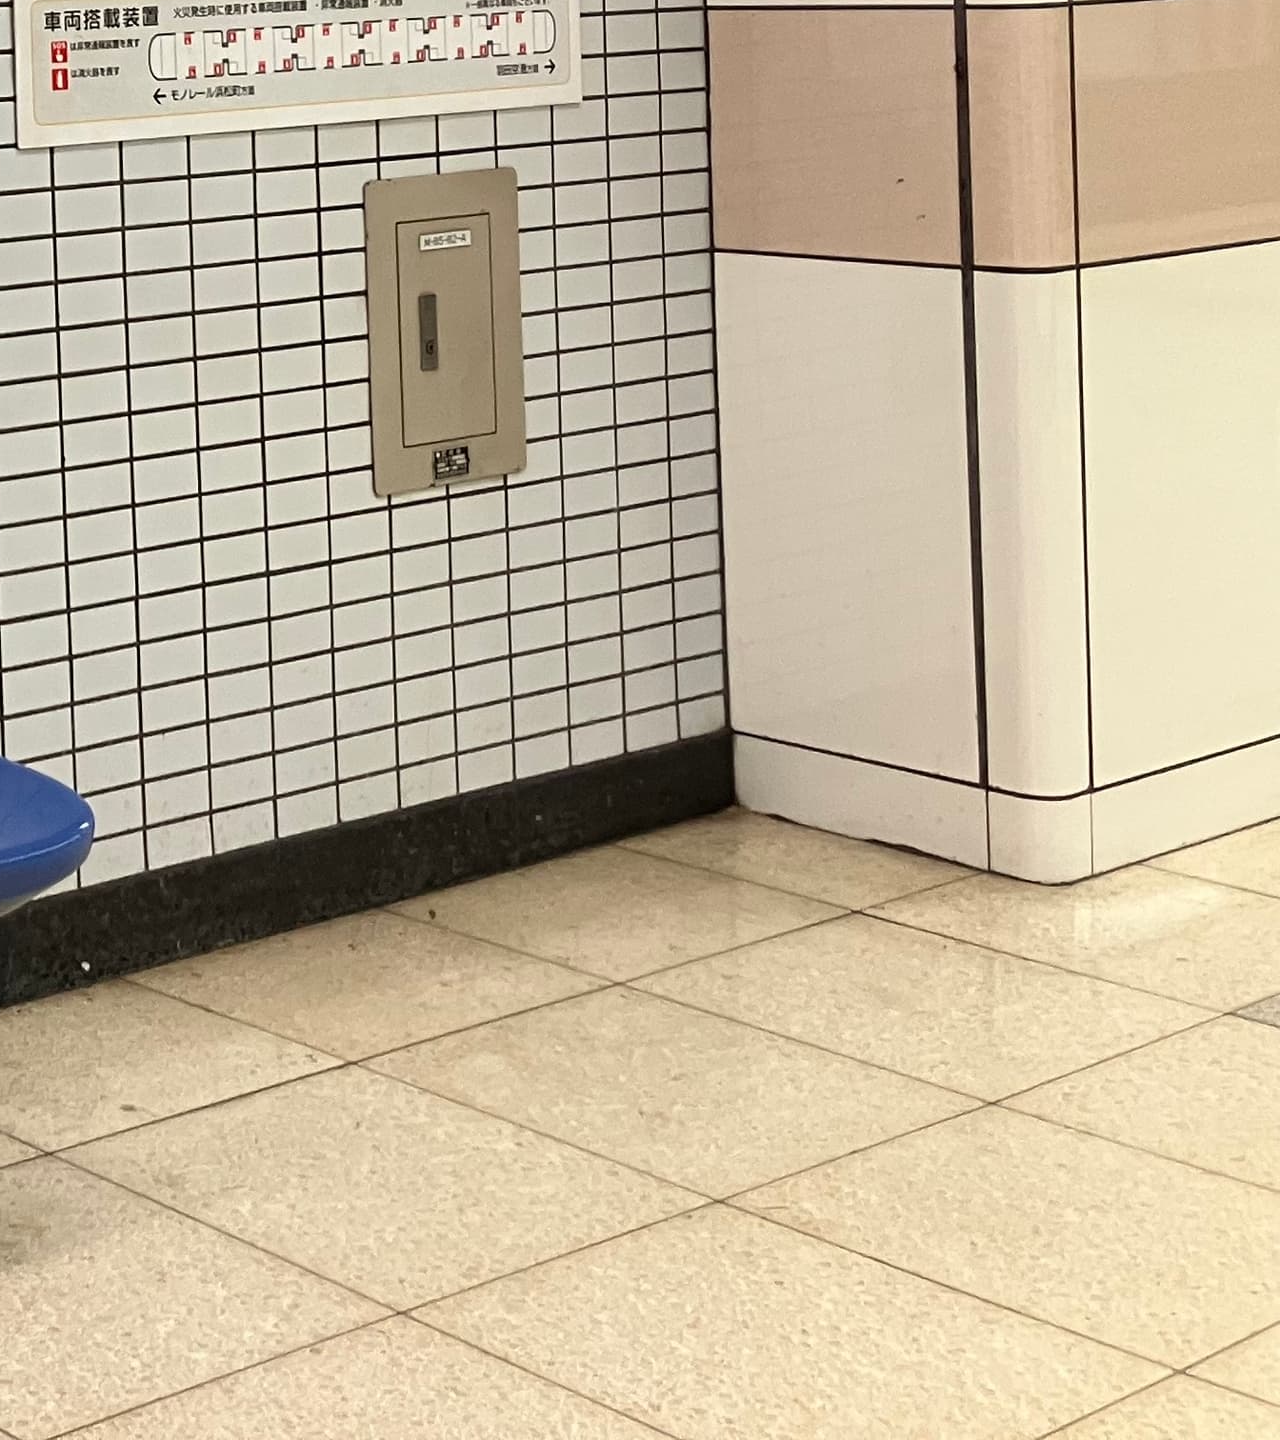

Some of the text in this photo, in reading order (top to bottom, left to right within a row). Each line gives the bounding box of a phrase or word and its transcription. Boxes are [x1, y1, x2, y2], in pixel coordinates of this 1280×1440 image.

[44, 6, 159, 32] 車両搭載装置
